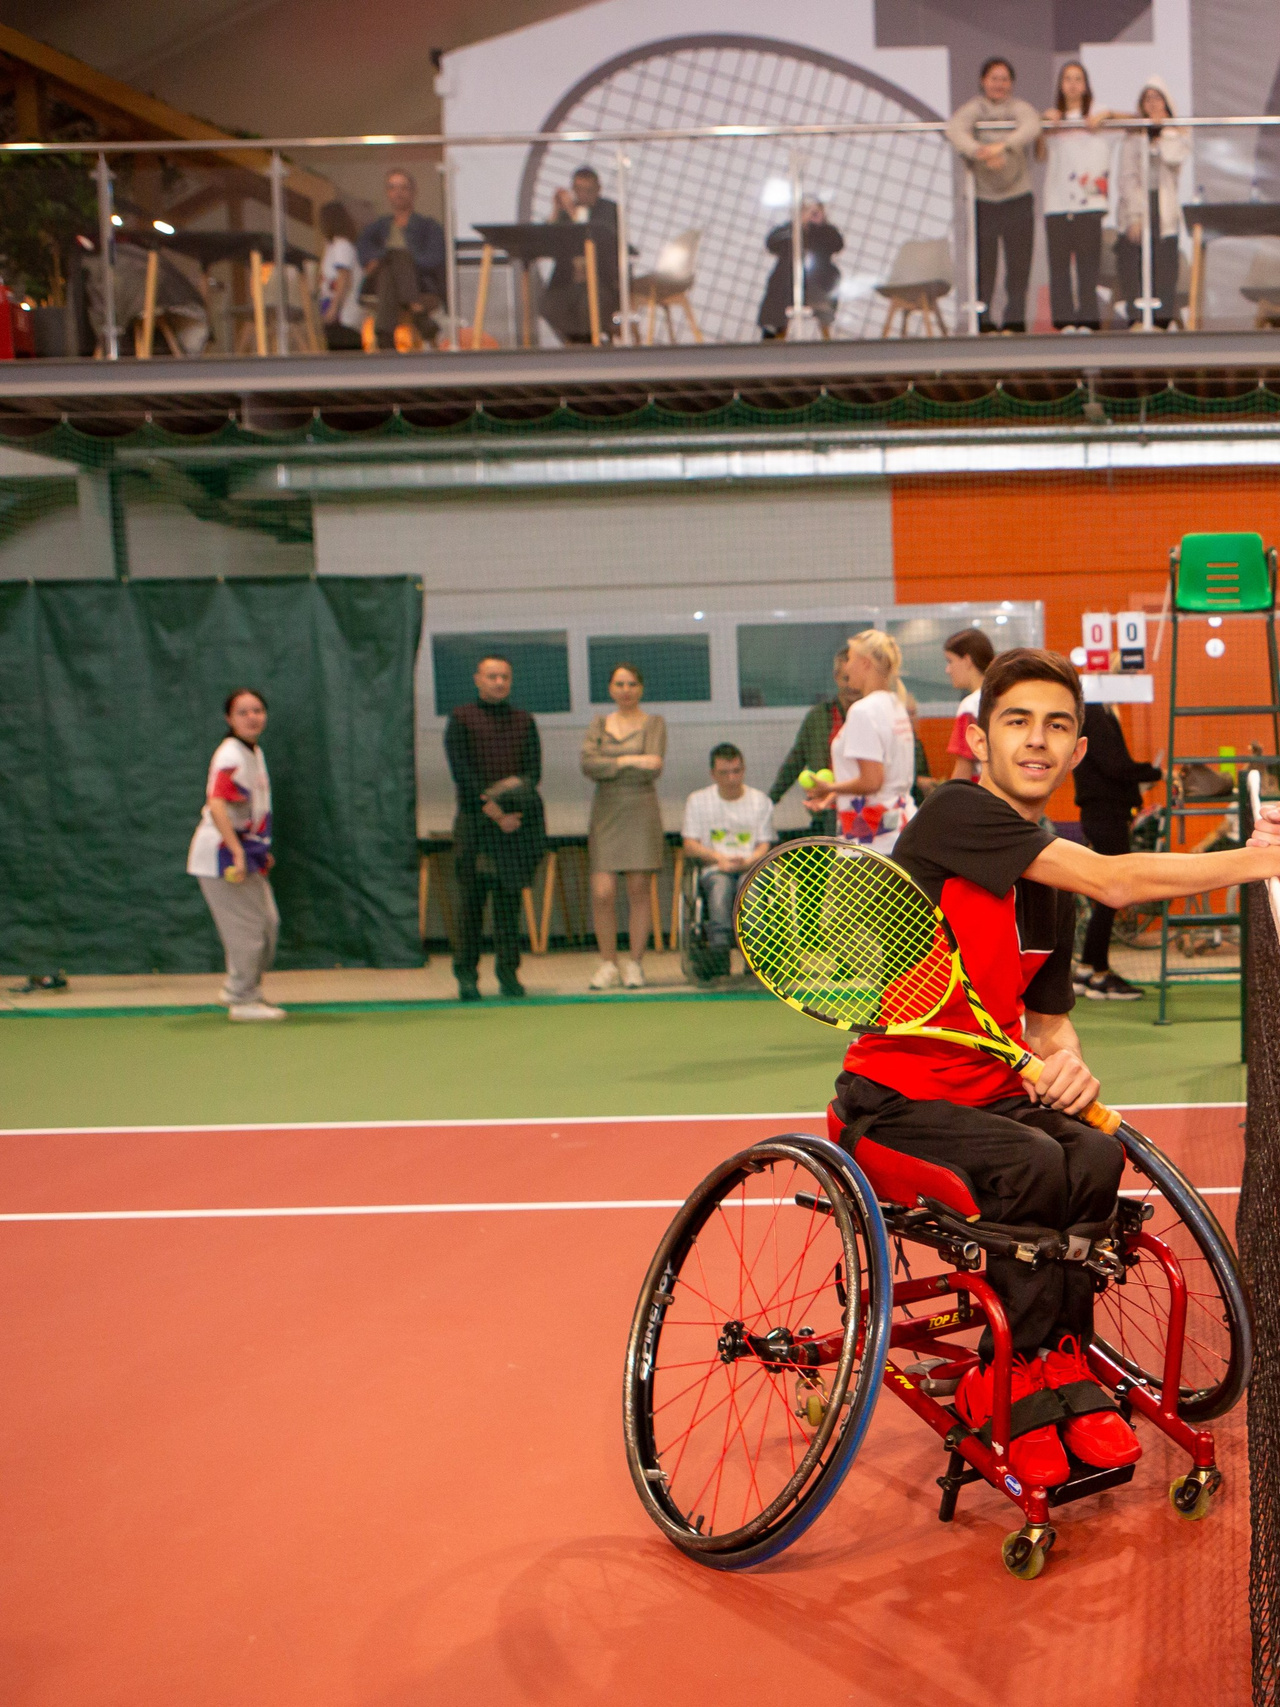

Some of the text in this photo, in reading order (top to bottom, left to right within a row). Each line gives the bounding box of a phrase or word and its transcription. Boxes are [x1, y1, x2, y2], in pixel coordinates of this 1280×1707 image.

[1091, 622, 1138, 643] 0 0
[640, 1260, 673, 1381] SPINEGY
[928, 1313, 951, 1329] TOP
